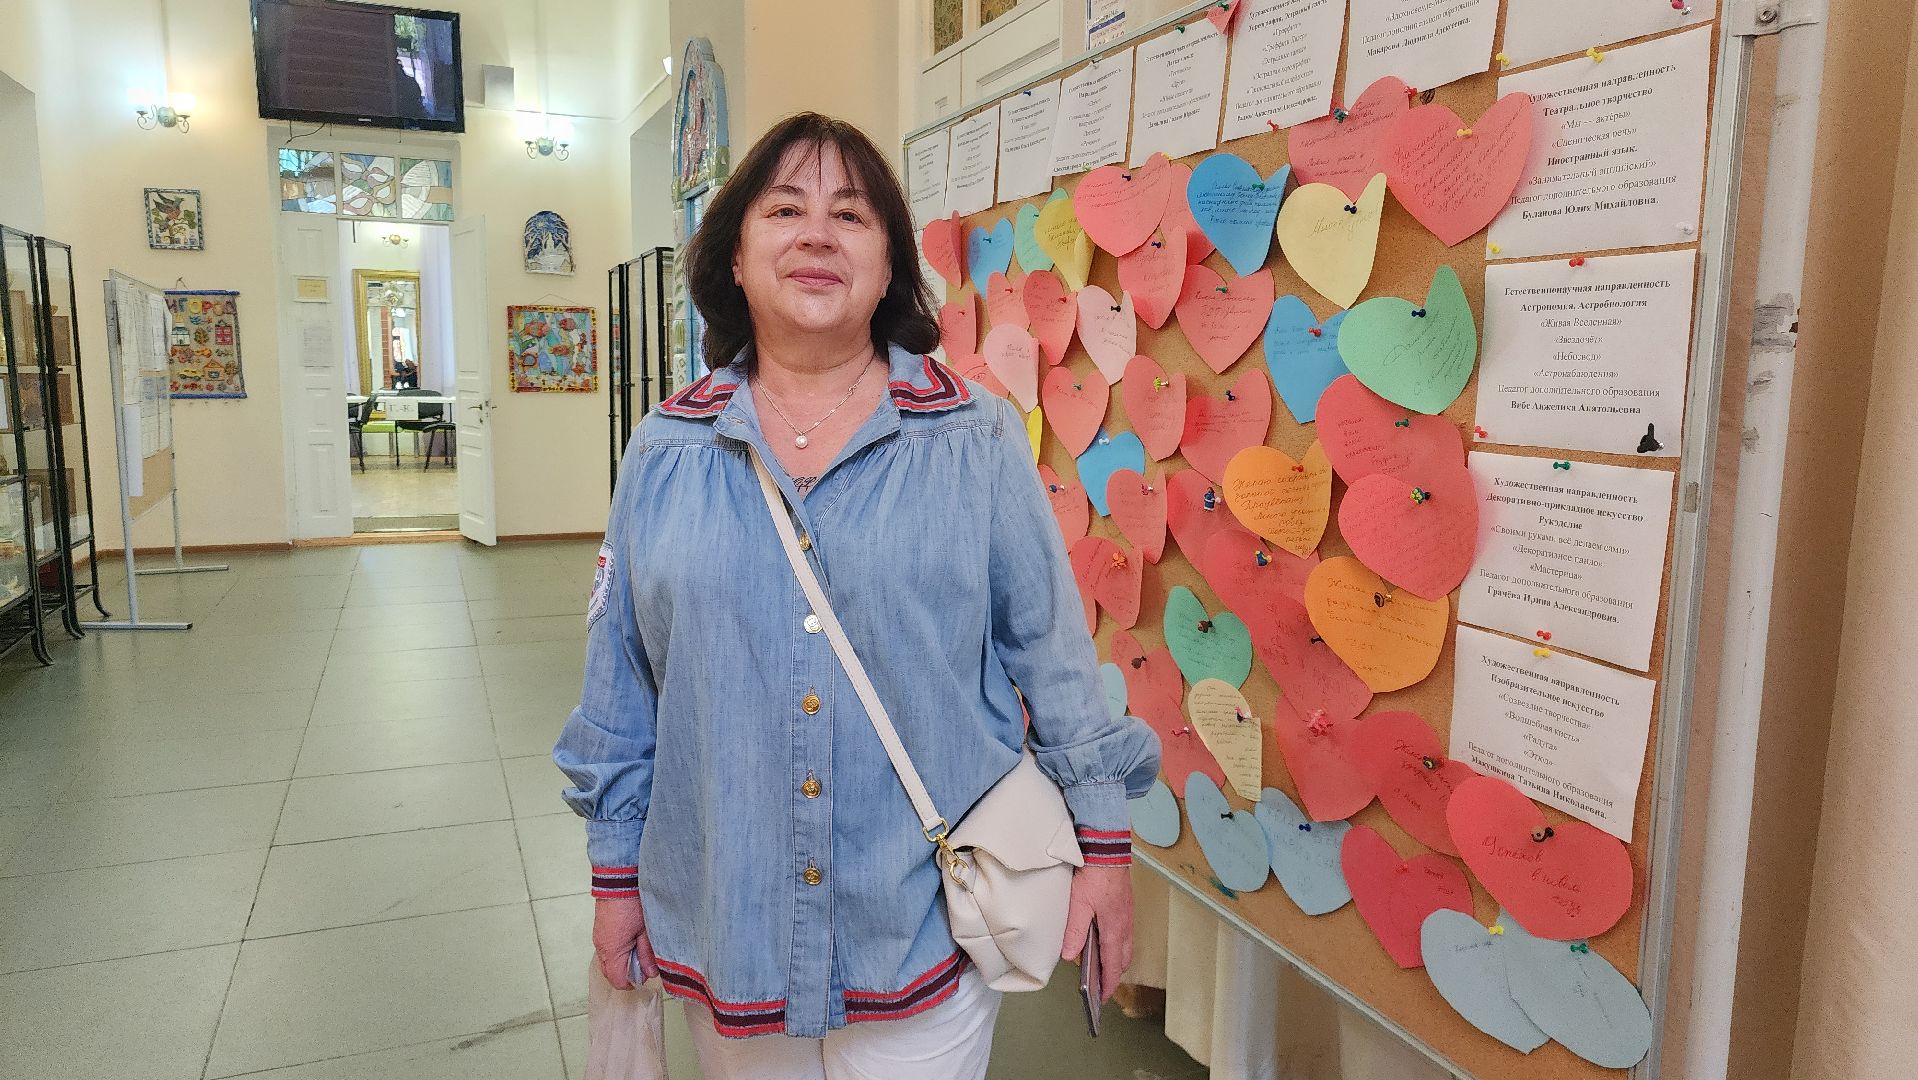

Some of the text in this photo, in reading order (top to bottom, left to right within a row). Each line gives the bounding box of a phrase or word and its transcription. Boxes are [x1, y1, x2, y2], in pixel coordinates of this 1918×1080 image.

[1601, 64, 1676, 89] направленность
[1543, 88, 1653, 117] Театральное творчество
[1547, 149, 1609, 167] Иностранный
[1618, 175, 1677, 191] образования
[1522, 205, 1562, 221] Буланова
[1594, 196, 1659, 212] Михайловна.
[1504, 279, 1671, 296] Естественнонаучная направленность
[1520, 299, 1647, 314] Астрономия, Астробиология
[1540, 318, 1622, 328] «Живая Вселенная»
[1533, 369, 1619, 379] «Астронаблюдения»
[1603, 387, 1660, 398] образования
[1532, 401, 1576, 413] Анжелика
[1578, 403, 1641, 414] Анатольевна
[1494, 477, 1638, 504] Художественная направленность
[1485, 493, 1644, 522] Декоративно-прикладное искусство
[1491, 526, 1527, 538] «Своими
[1538, 515, 1583, 530] Рукоделие
[1479, 569, 1633, 609] Педагог дополнительного образования
[1487, 586, 1619, 624] Грачёва Ирина Александровна.
[1481, 655, 1620, 706] Художественная направленность
[1491, 674, 1605, 718] Изобразительное искусство
[1499, 693, 1543, 713] «Созвездие
[1505, 711, 1553, 733] «Волшебная
[1523, 733, 1558, 751] «Радуга»
[1496, 753, 1561, 787] дополнительного
[1562, 780, 1614, 808] образования
[1518, 773, 1551, 795] Татьяна
[1553, 789, 1607, 819] Николаевна.
[1482, 834, 1544, 864] Успехов
